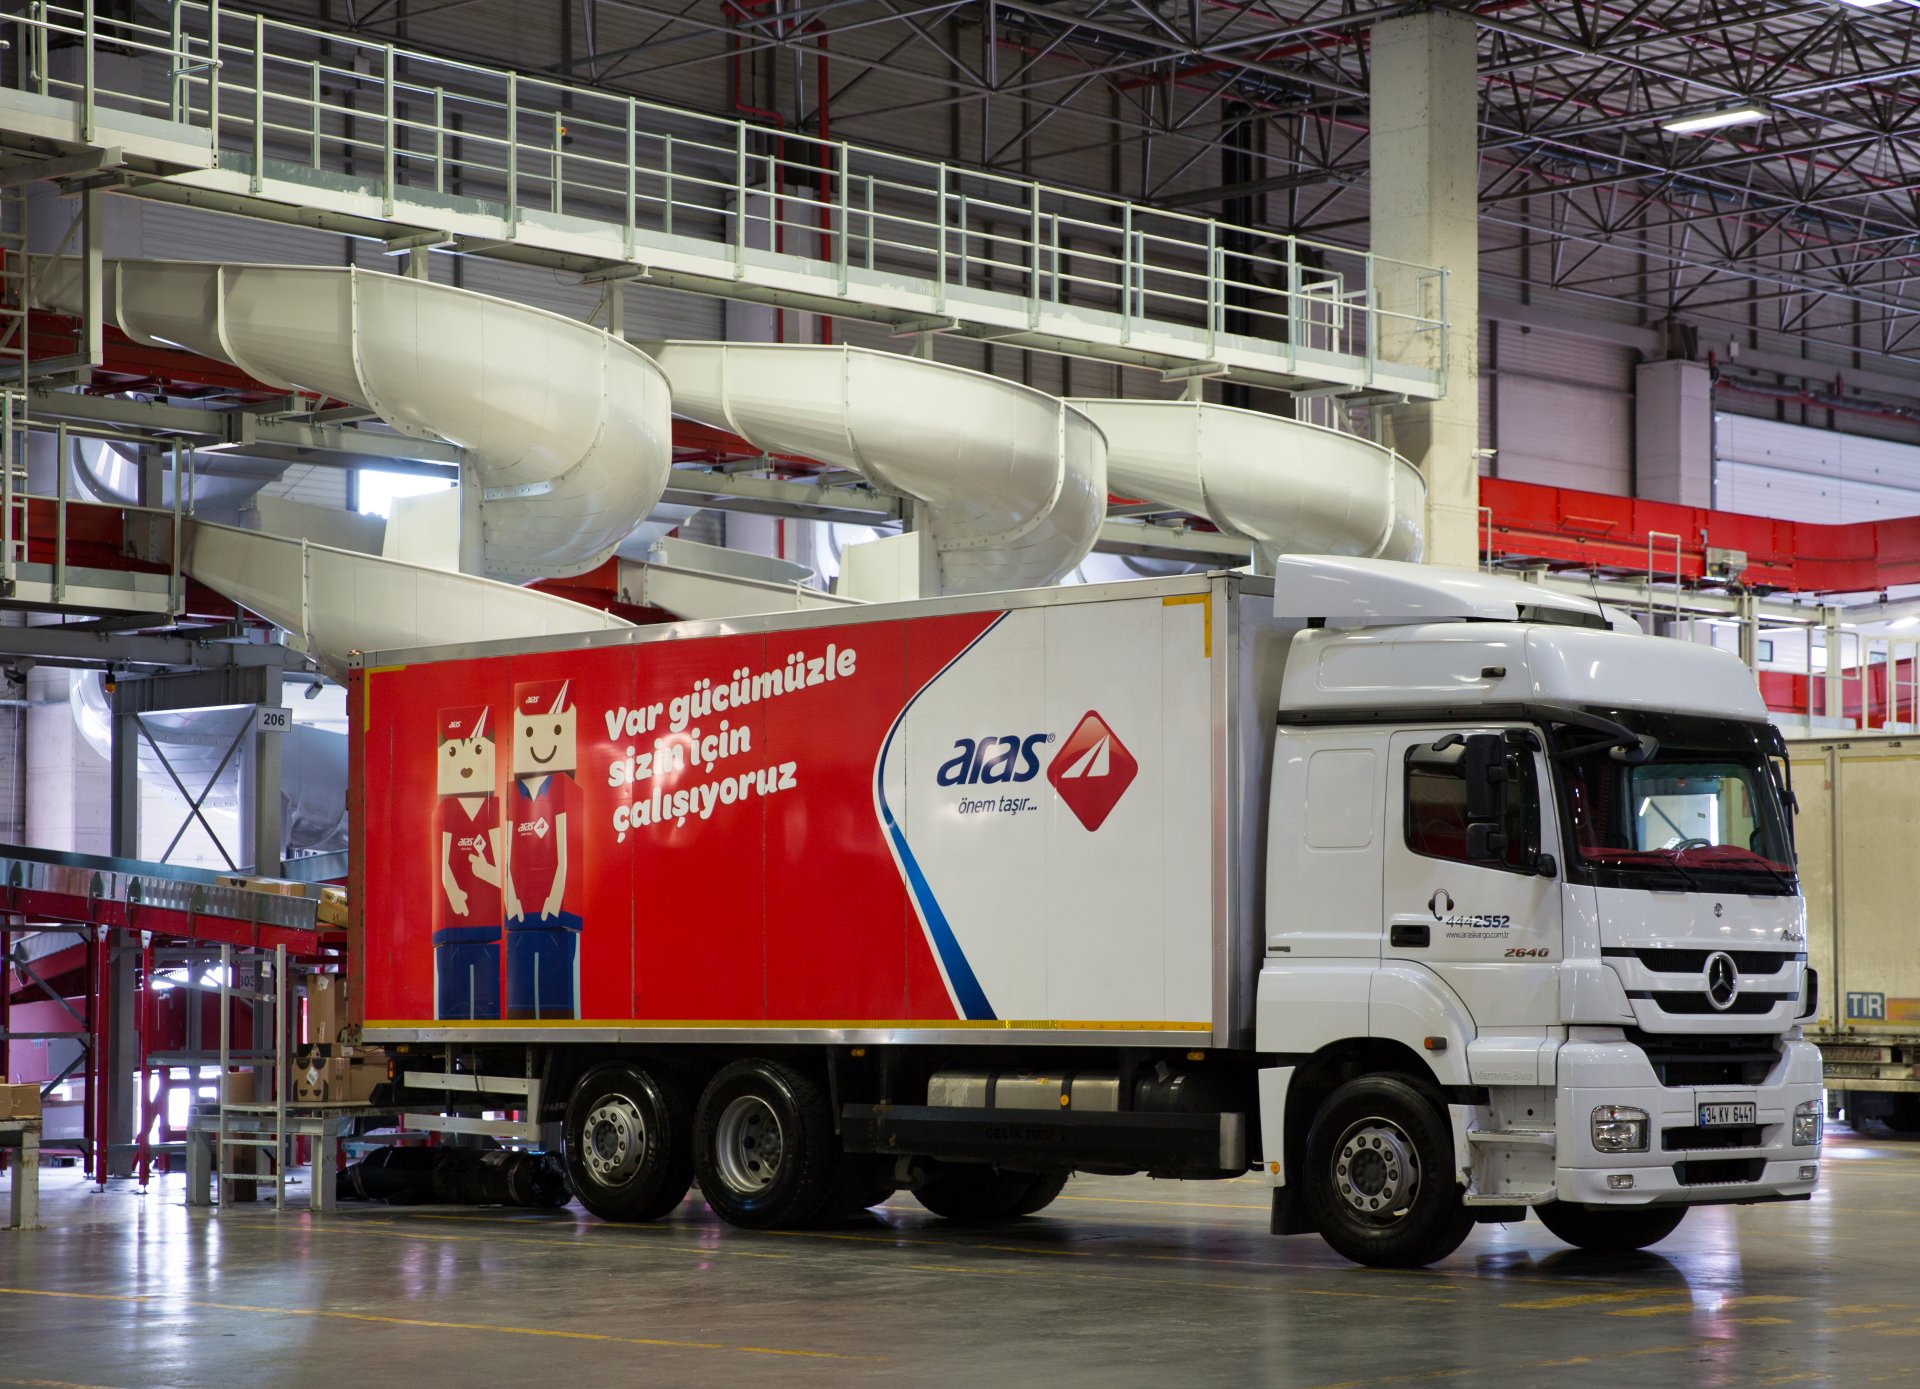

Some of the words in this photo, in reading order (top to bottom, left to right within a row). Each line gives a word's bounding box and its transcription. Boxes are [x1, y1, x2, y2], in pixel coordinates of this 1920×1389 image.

[605, 702, 663, 741] Var
[669, 643, 857, 733] gücümüzle
[263, 712, 285, 727] 206
[608, 733, 686, 788] sizin
[691, 720, 751, 773] için
[612, 761, 797, 843] çalışıyoruz
[958, 798, 995, 814] önem
[1504, 948, 1549, 958] 2640
[1849, 994, 1883, 1018] TIR
[1706, 1107, 1717, 1123] 34
[1733, 1106, 1753, 1122] 6441
